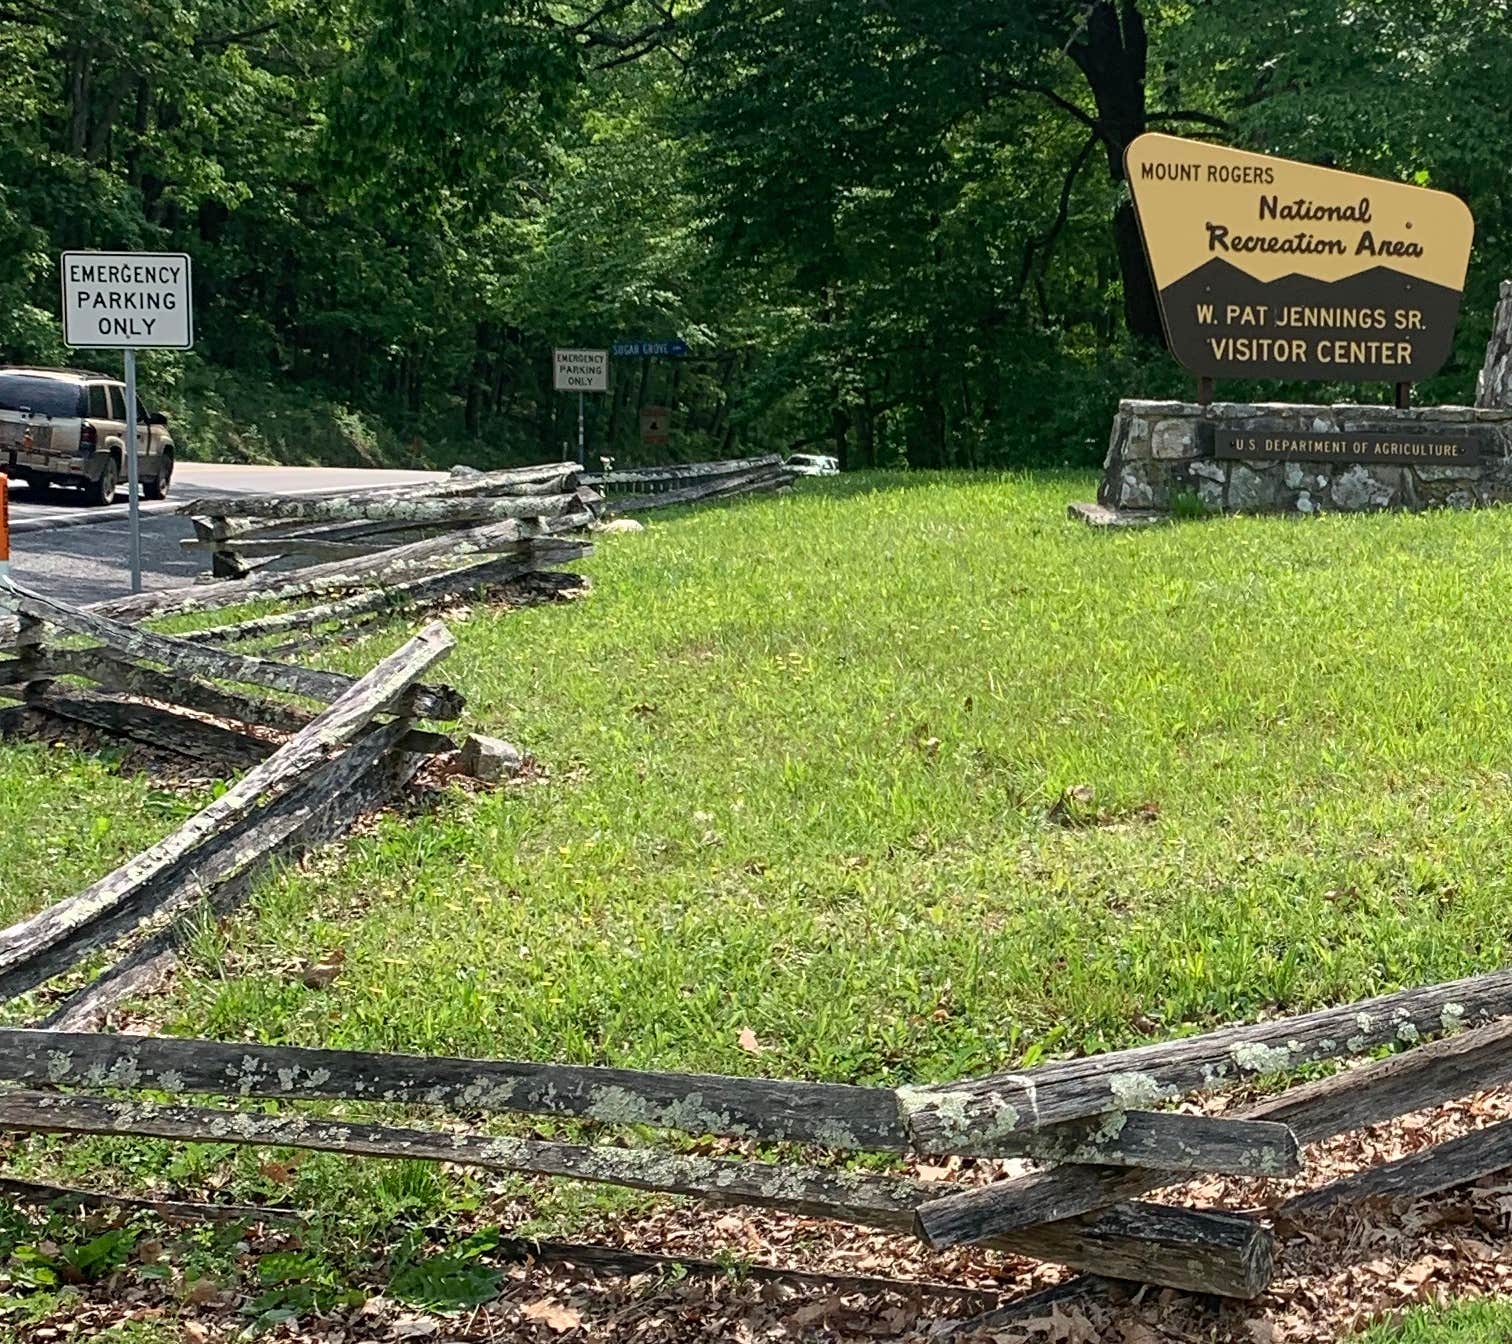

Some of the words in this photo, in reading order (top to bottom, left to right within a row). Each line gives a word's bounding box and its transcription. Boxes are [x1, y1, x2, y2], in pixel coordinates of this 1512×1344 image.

[1141, 162, 1202, 182] MOUNT
[1207, 165, 1275, 184] ROGERS
[1259, 194, 1372, 223] National
[1206, 223, 1347, 256] Recreation
[1354, 230, 1424, 258] Area
[70, 264, 181, 285] EMERGENCY
[77, 291, 177, 310] PARKING
[98, 317, 157, 336] ONLY
[1196, 304, 1218, 325] W.
[1226, 305, 1269, 326] PAT
[1275, 306, 1387, 329] JENNINGS
[1394, 309, 1427, 330] SR.
[556, 354, 604, 364] EMERGENCY
[1211, 337, 1308, 362] VISITOR
[1316, 340, 1413, 365] CENTER
[560, 365, 602, 375] PARKING
[567, 377, 593, 386] ONLY
[1265, 439, 1347, 453] DEPARTMENT
[1353, 442, 1369, 454] OF
[1374, 442, 1458, 456] AGRICULTURE
